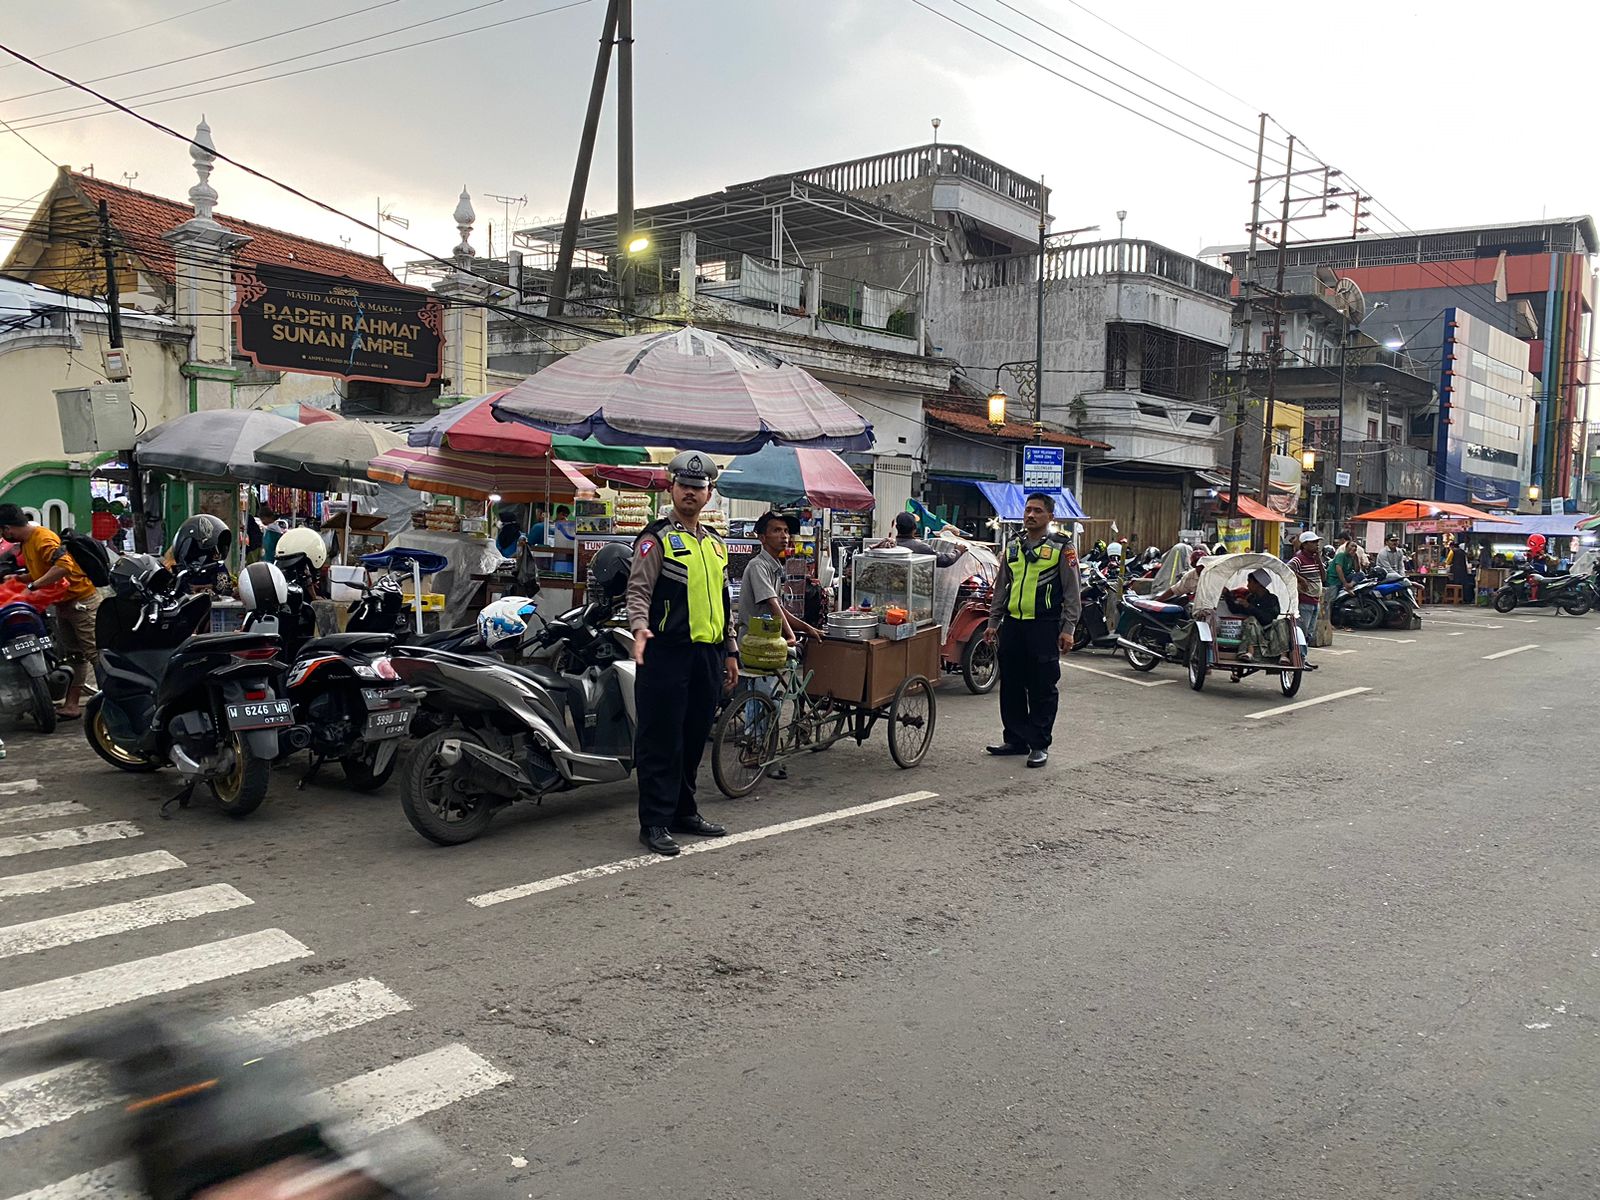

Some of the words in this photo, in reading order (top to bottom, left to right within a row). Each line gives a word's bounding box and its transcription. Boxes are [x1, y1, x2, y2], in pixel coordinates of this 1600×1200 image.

[286, 290, 321, 302] MASJID
[323, 296, 357, 308] AGUNG
[367, 302, 403, 315] MAKAM
[263, 302, 336, 328] RADEN
[341, 314, 421, 341] RAHMAT
[272, 324, 345, 349] SUNAN
[357, 336, 414, 358] AMPEL
[229, 707, 238, 718] W
[244, 704, 269, 716] 6246
[274, 703, 288, 714] WB
